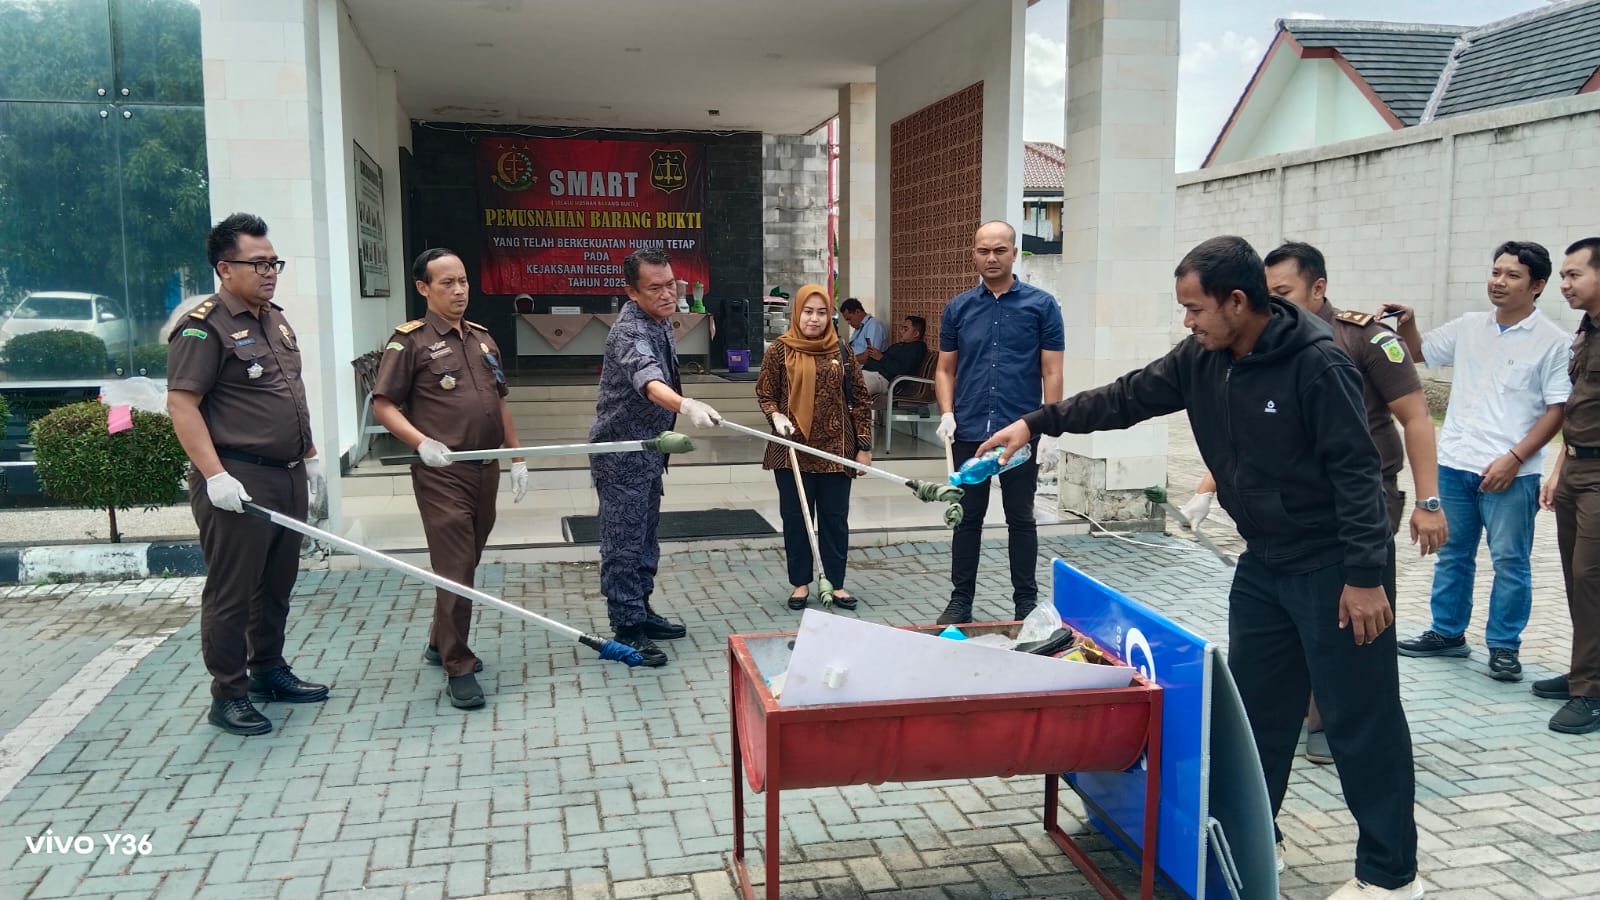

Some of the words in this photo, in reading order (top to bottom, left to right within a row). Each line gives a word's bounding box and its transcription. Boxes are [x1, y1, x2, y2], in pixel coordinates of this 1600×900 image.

[550, 170, 639, 198] SMART
[484, 208, 585, 228] PEMUSNAHAN
[590, 210, 652, 229] BARANG
[655, 212, 702, 229] BUKTI
[493, 237, 520, 248] YANG
[523, 237, 554, 248] TELAH
[557, 238, 626, 249] BERKEKUATAN
[629, 239, 664, 249] HUKUM
[666, 239, 696, 249] TETAP
[583, 251, 610, 261] PADA
[526, 264, 584, 275] KEJAKSAAN
[586, 265, 623, 275] NEGERI
[568, 277, 600, 288] TAHUN
[603, 277, 626, 288] 2025
